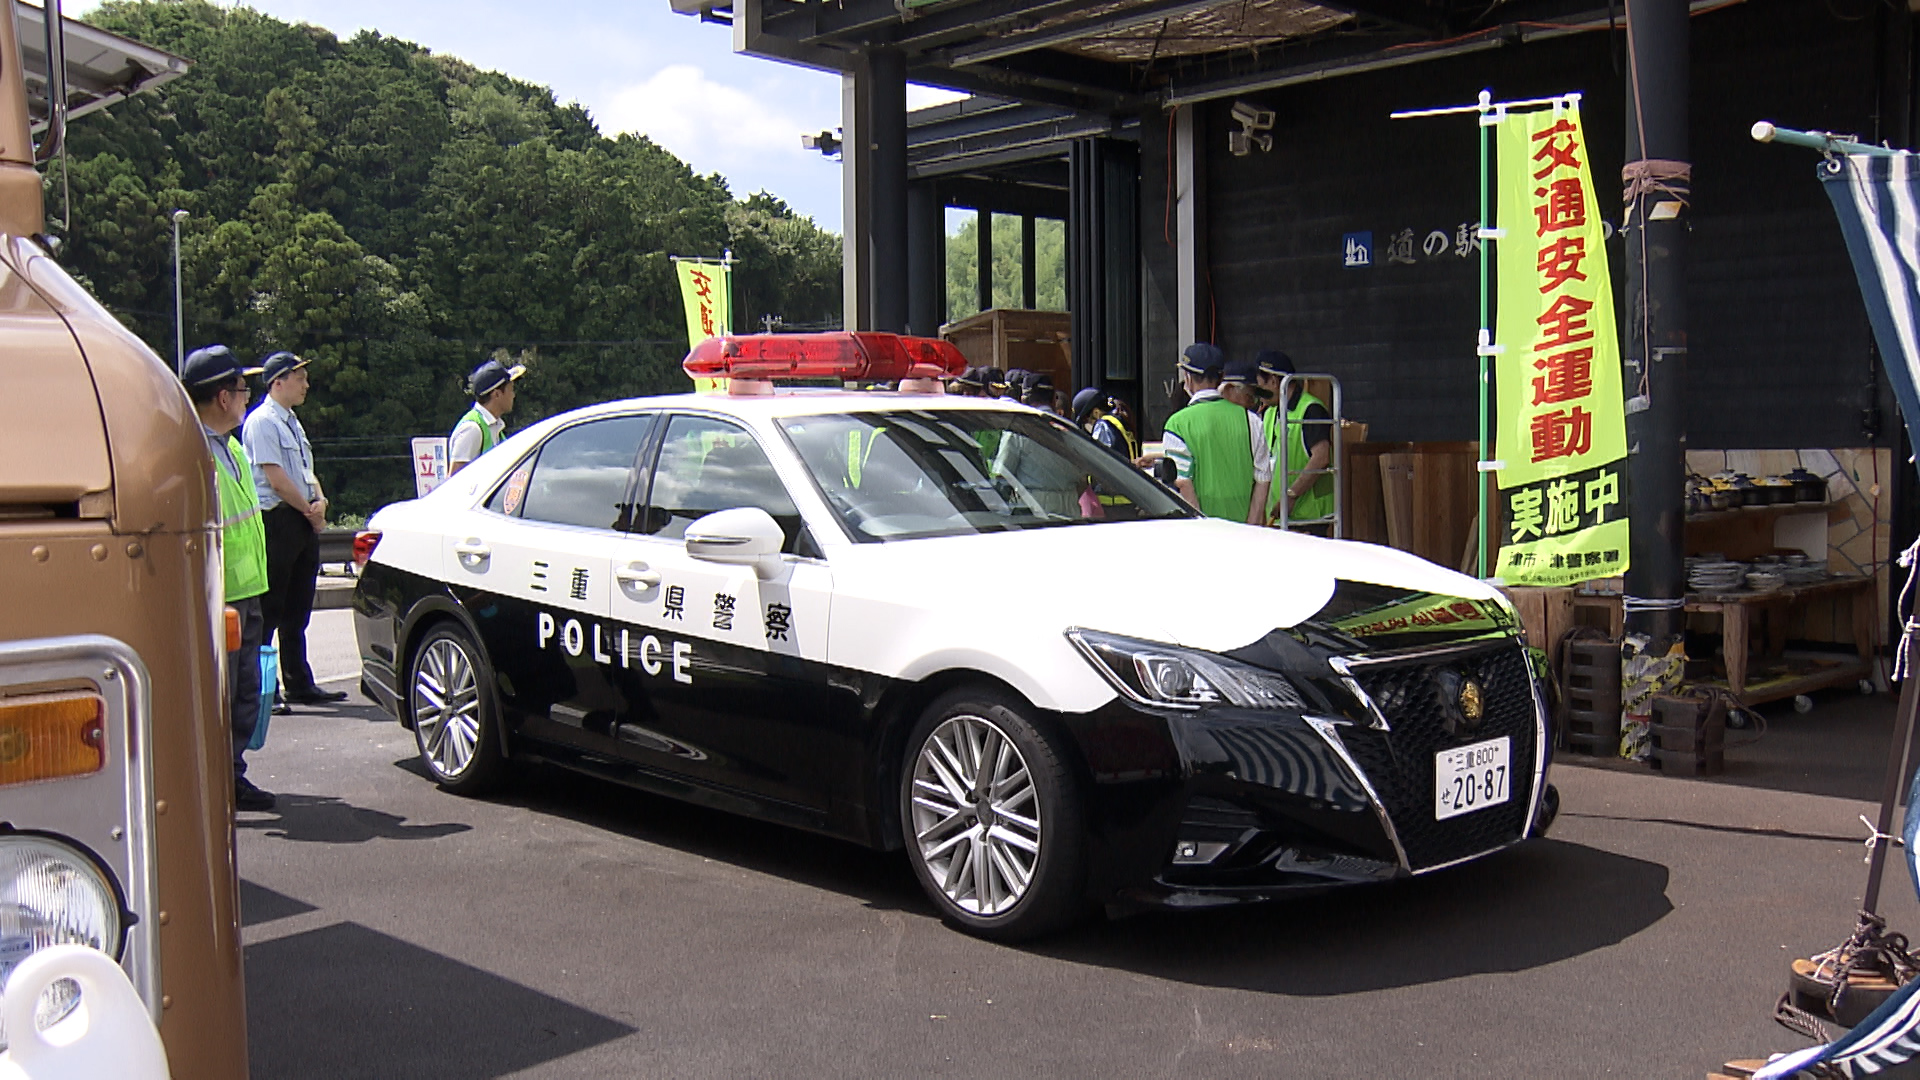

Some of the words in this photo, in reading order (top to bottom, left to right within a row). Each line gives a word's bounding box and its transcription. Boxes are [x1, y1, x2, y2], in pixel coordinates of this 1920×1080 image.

[1531, 119, 1594, 463] 交通安全運動
[1510, 468, 1620, 544] 実施中
[537, 611, 693, 685] POLICE
[1453, 765, 1505, 810] 20-87
